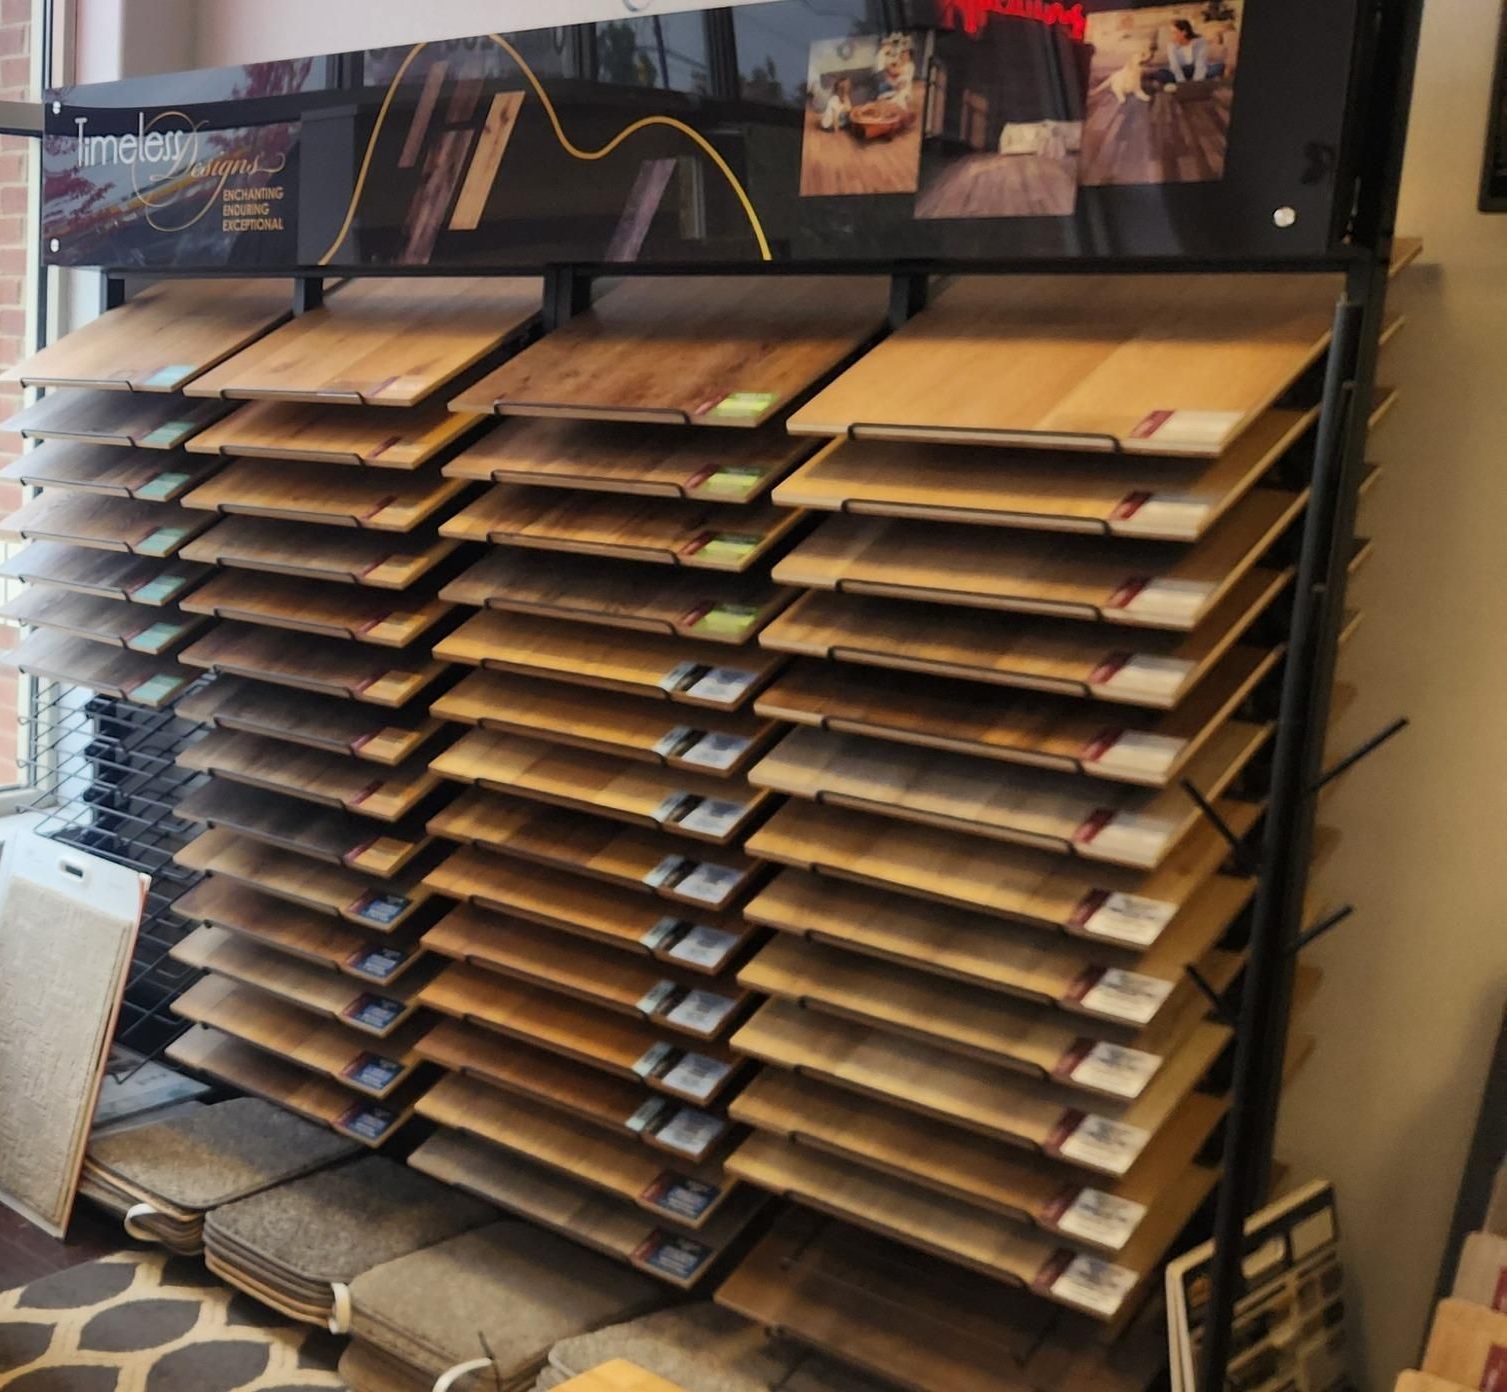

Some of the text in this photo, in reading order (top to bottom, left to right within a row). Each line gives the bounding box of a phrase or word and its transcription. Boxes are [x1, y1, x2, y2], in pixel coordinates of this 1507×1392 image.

[74, 112, 184, 167] Timeless
[223, 187, 284, 202] ENCHANTING
[223, 203, 270, 217] ENDURING
[223, 218, 284, 232] EXCEPTIONAL
